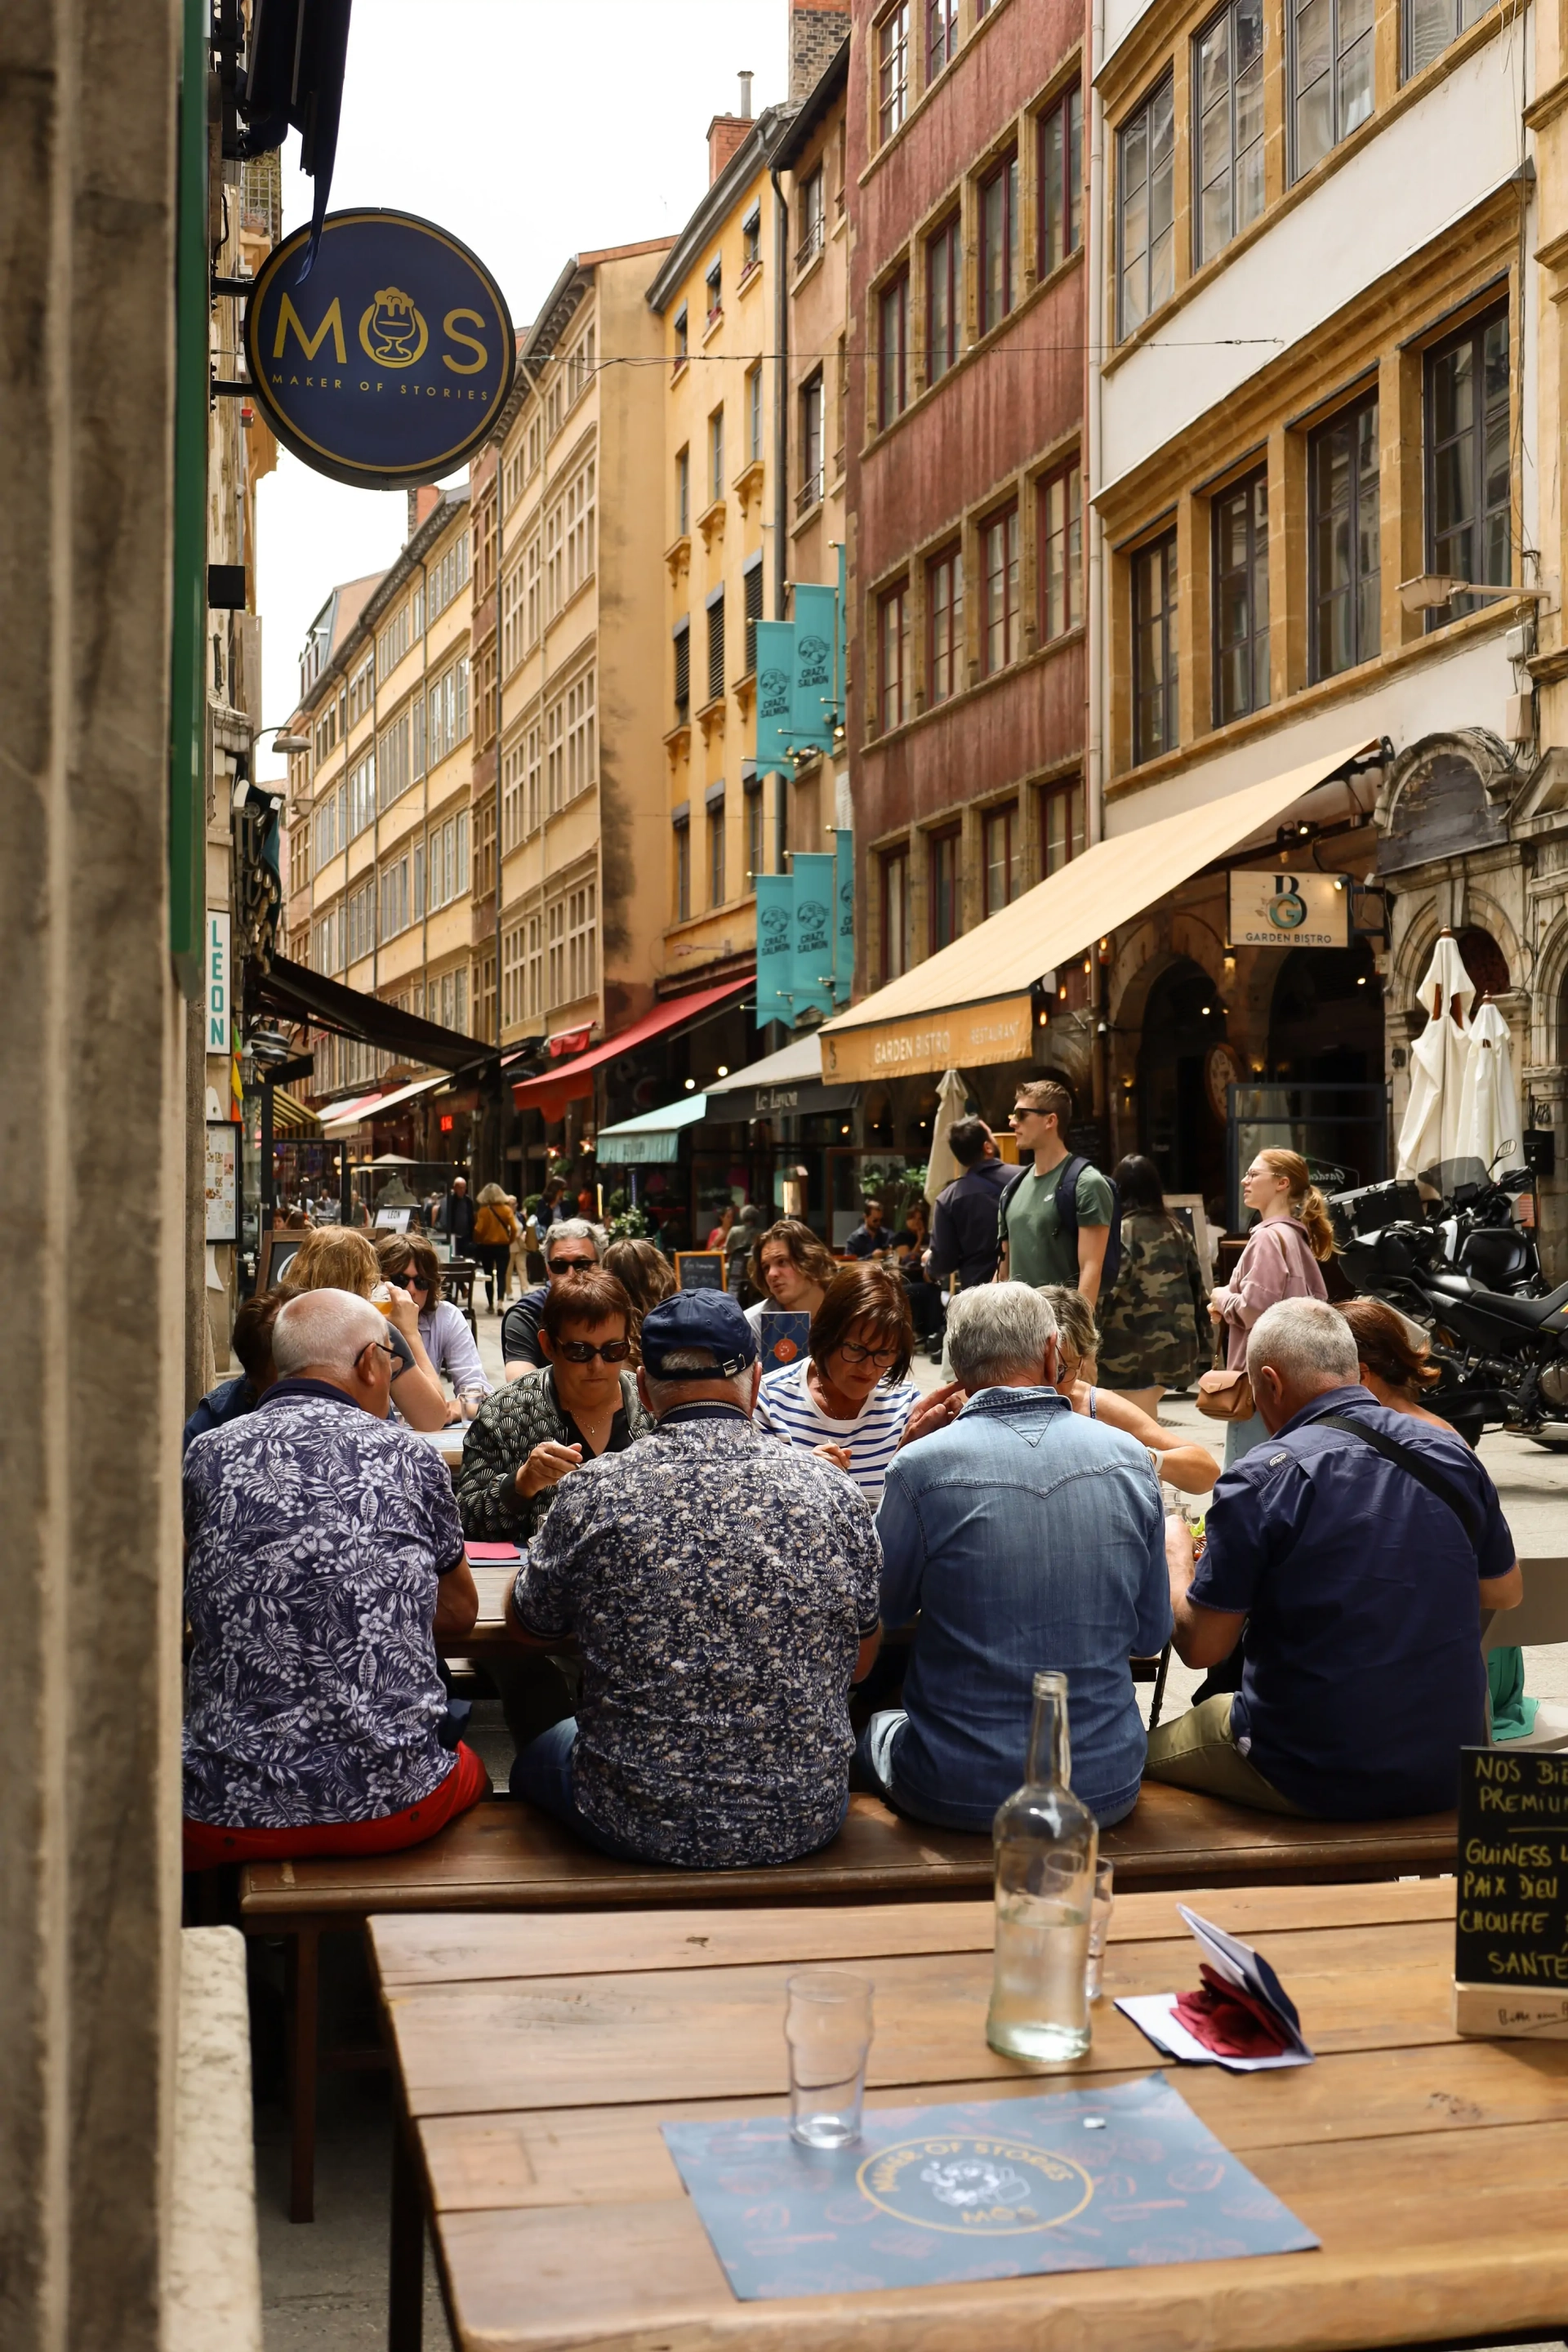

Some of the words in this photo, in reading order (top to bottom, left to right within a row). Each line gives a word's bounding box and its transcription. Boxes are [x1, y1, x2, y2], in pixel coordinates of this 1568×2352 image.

[272, 289, 488, 375] MOS
[272, 373, 342, 390] MAKER
[359, 381, 384, 393] OF
[400, 384, 488, 401] STORIES
[801, 665, 826, 679] CRAZY
[798, 675, 829, 688] SALMON
[763, 697, 786, 710] CRAZY
[760, 705, 790, 719] SALMON
[764, 933, 787, 947] CRAZY
[800, 930, 825, 944] CRAZY
[1245, 932, 1290, 943] GARDEN
[1294, 933, 1332, 944] BISTRO
[761, 942, 791, 956] SALMON
[797, 939, 828, 954] SALMON
[874, 1036, 913, 1065] GARDEN
[915, 1030, 951, 1058] BISTRO
[969, 1021, 1021, 1046] RESTAURANT
[1475, 1755, 1521, 1783] NOS
[1459, 1909, 1550, 1935] CHOUFFE
